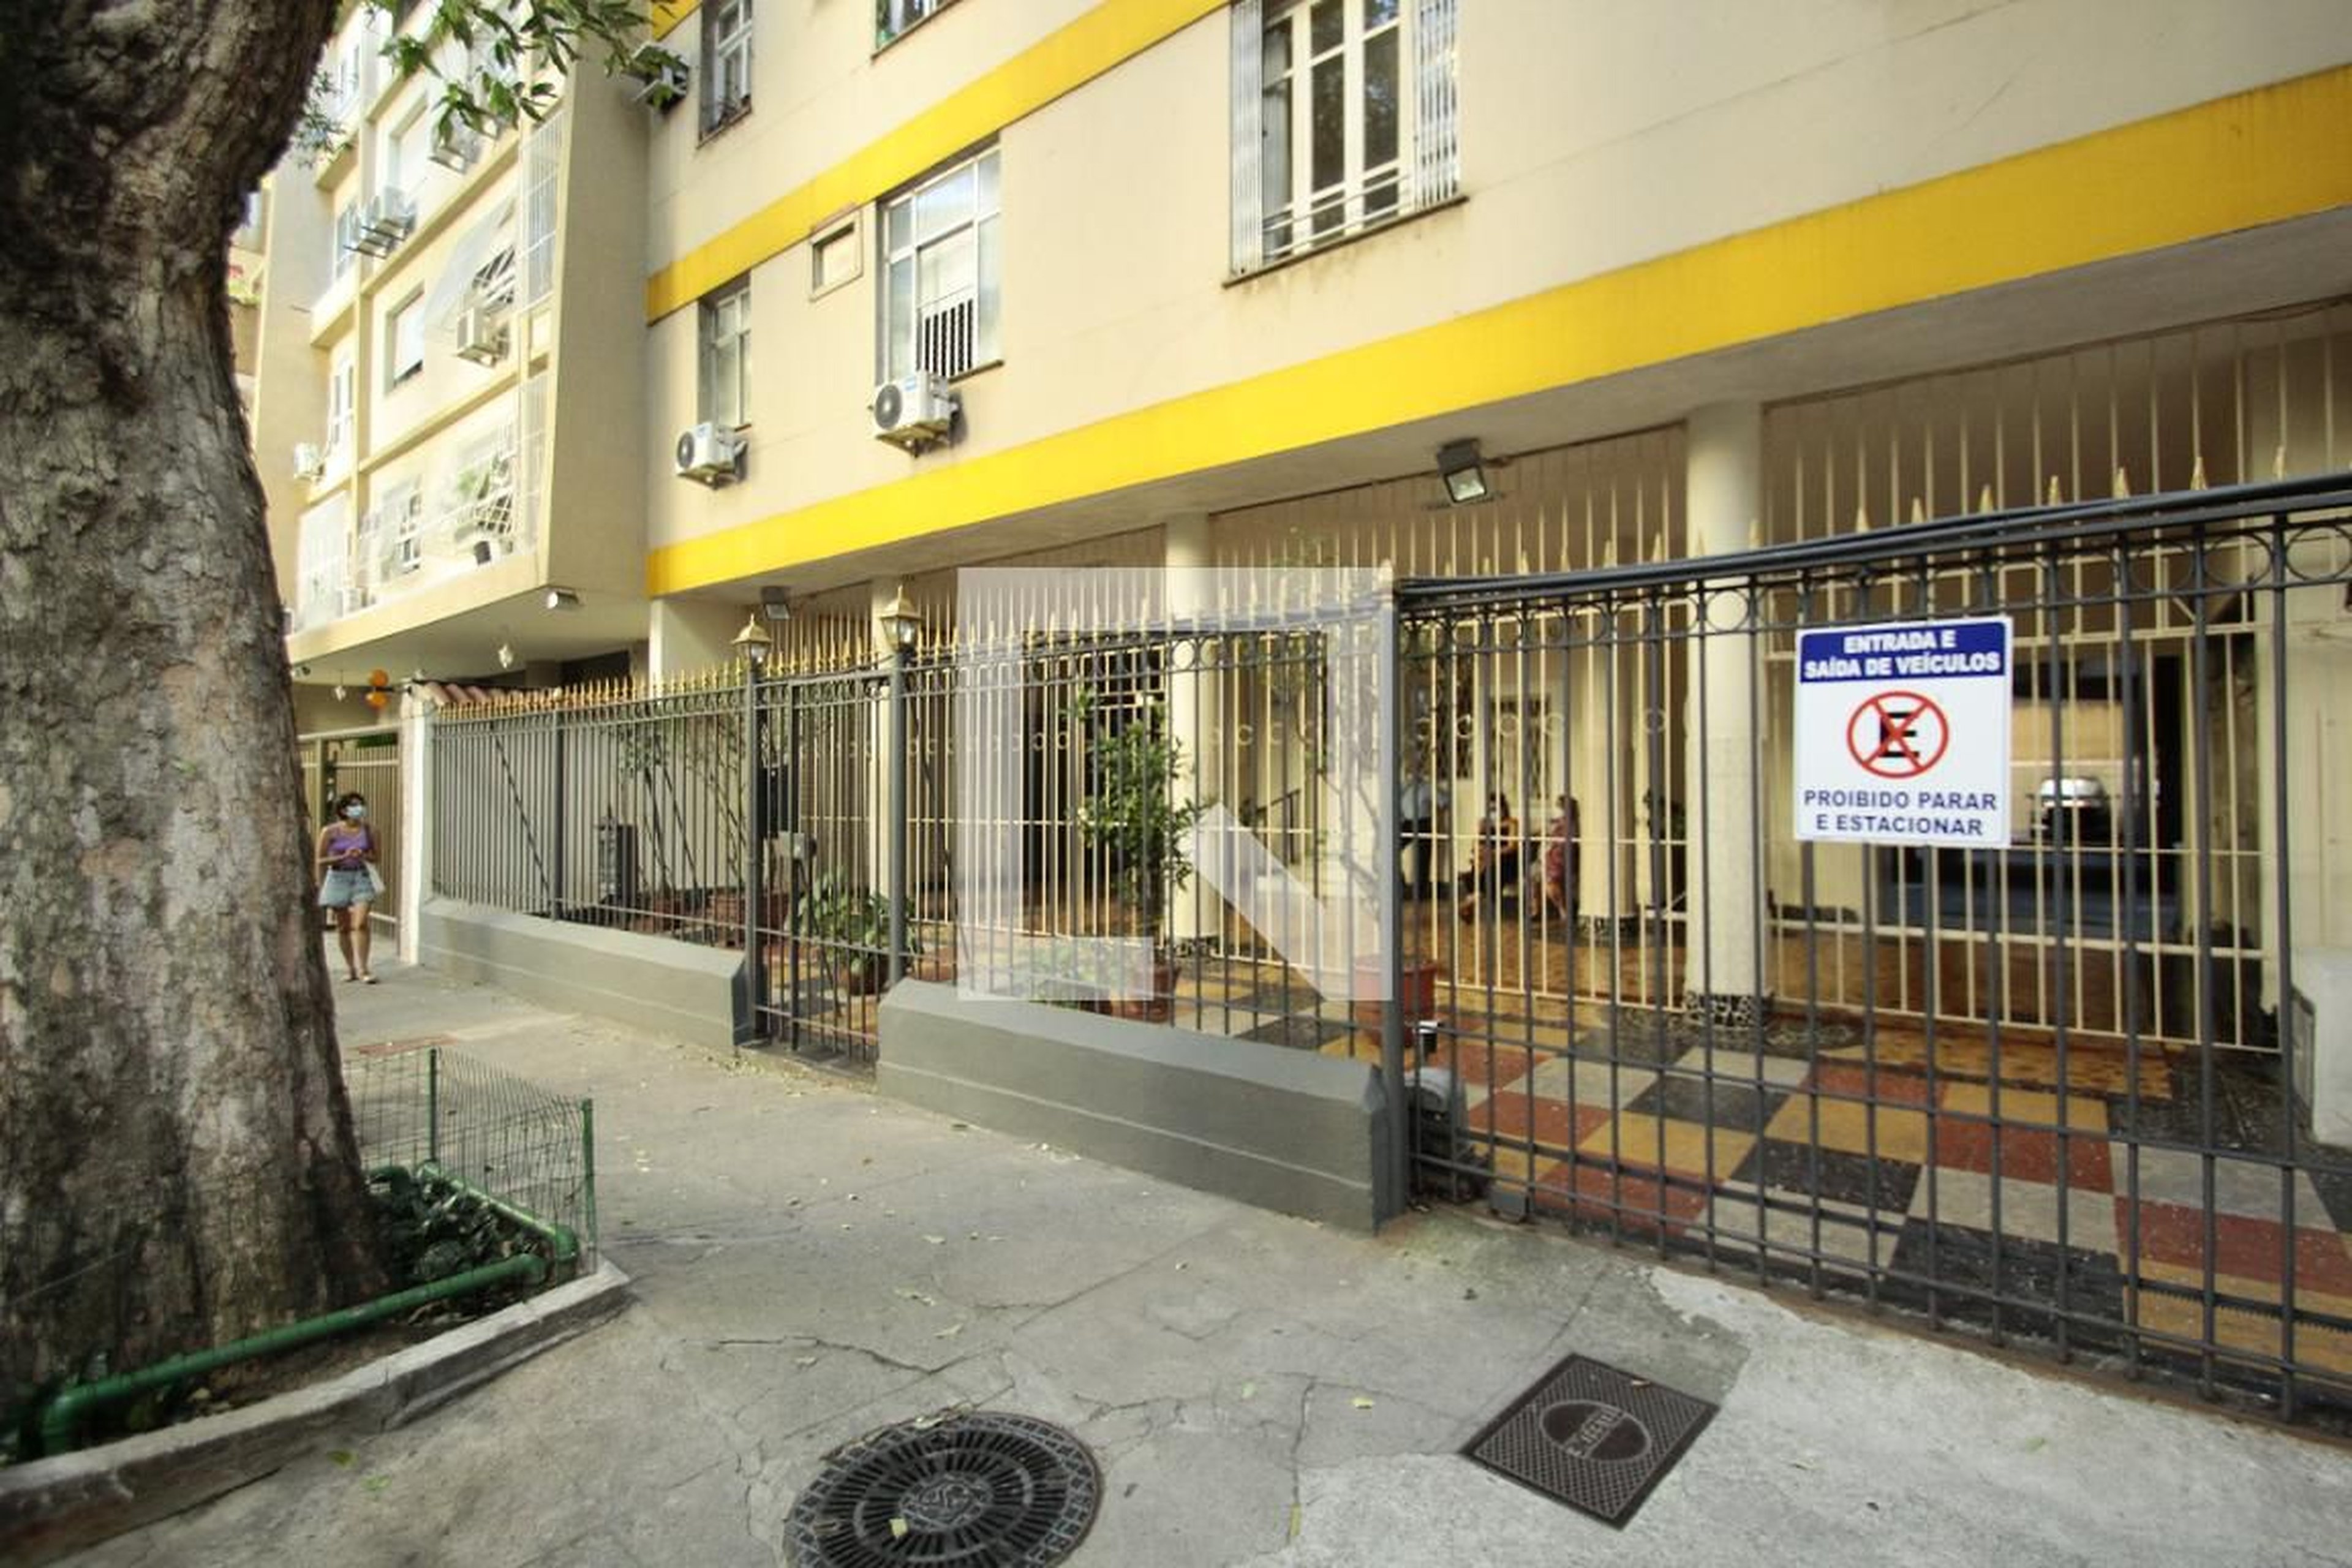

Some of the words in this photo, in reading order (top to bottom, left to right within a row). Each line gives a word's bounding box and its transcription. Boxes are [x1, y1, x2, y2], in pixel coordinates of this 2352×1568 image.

[1844, 631, 1936, 654] ENTRADA
[1941, 630, 1956, 647] E
[1804, 657, 1862, 679] SAÍDA
[1865, 657, 1892, 676] DE
[1896, 651, 2000, 674] VEÍCULOS
[1804, 790, 1910, 809] PROIBIDO
[1918, 792, 1997, 811] PARAR
[1816, 814, 1828, 831] E
[1837, 815, 1983, 836] ESTACIONAR
